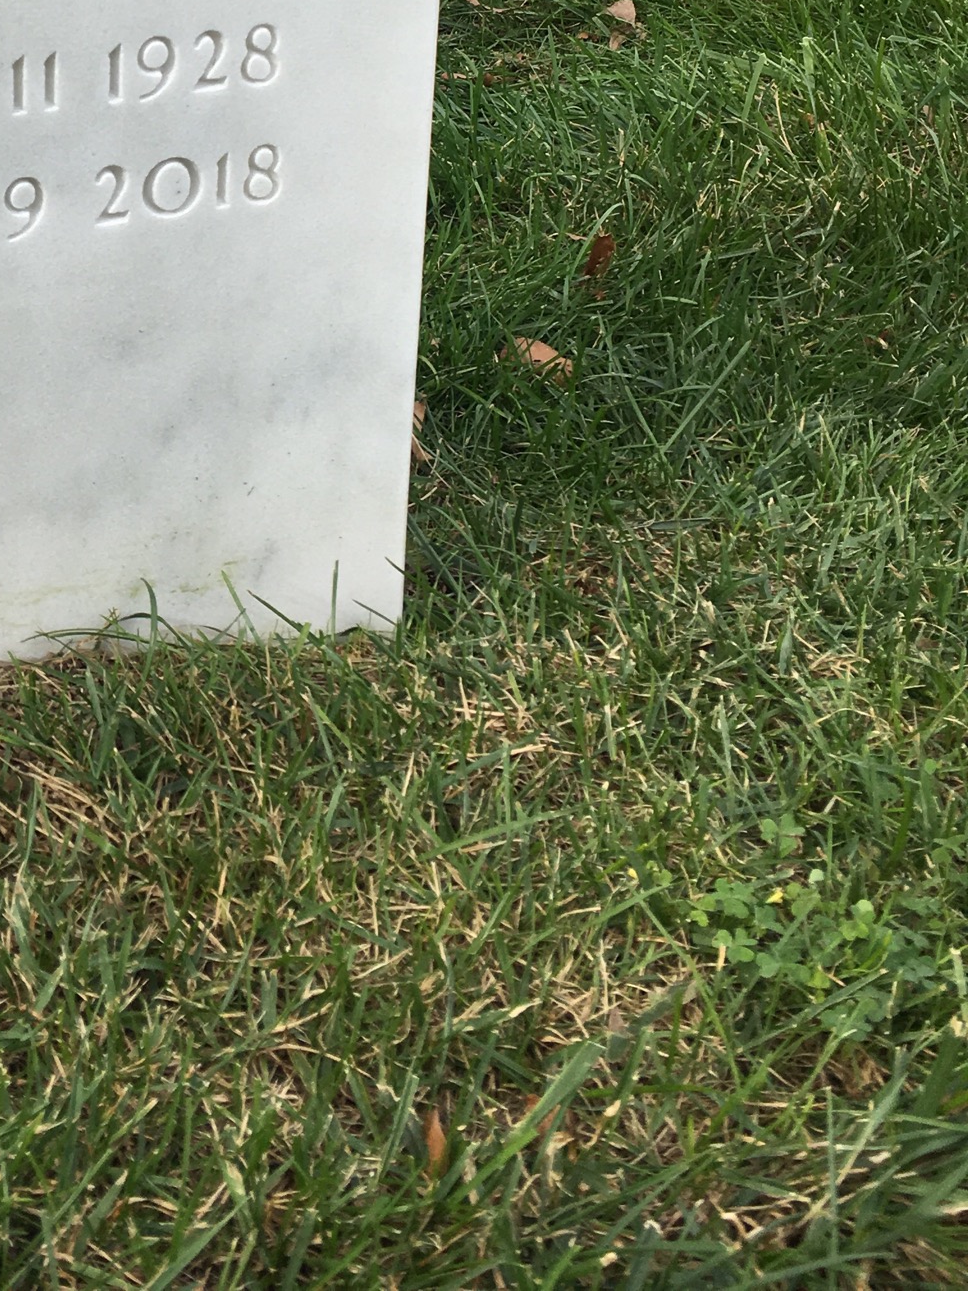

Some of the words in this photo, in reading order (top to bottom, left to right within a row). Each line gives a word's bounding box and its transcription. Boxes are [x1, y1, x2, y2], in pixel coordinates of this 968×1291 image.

[10, 51, 60, 116] 11
[107, 23, 280, 105] 1928
[2, 176, 47, 242] 9
[95, 143, 282, 227] 2018
